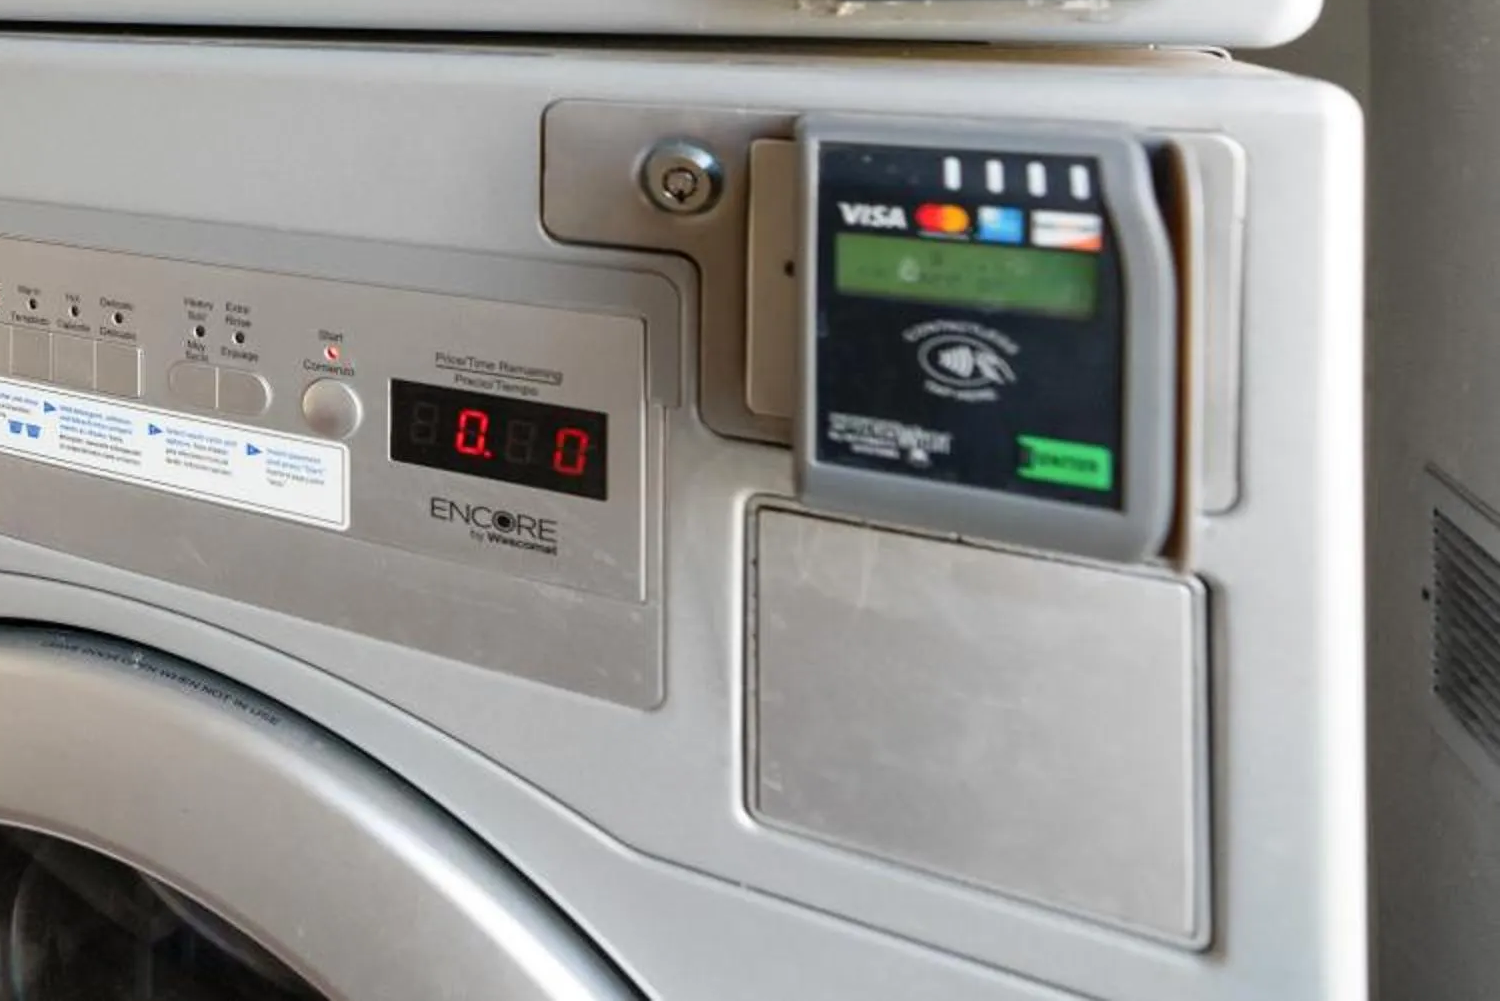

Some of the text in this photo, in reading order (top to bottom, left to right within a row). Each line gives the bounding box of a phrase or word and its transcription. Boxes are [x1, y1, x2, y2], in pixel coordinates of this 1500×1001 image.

[837, 202, 907, 232] VISA
[319, 330, 343, 343] Start
[430, 497, 558, 543] ENCORE
[487, 531, 558, 556] Wascomat
[160, 670, 200, 689] WHEN
[202, 685, 233, 703] NOT
[249, 707, 279, 726] USE
